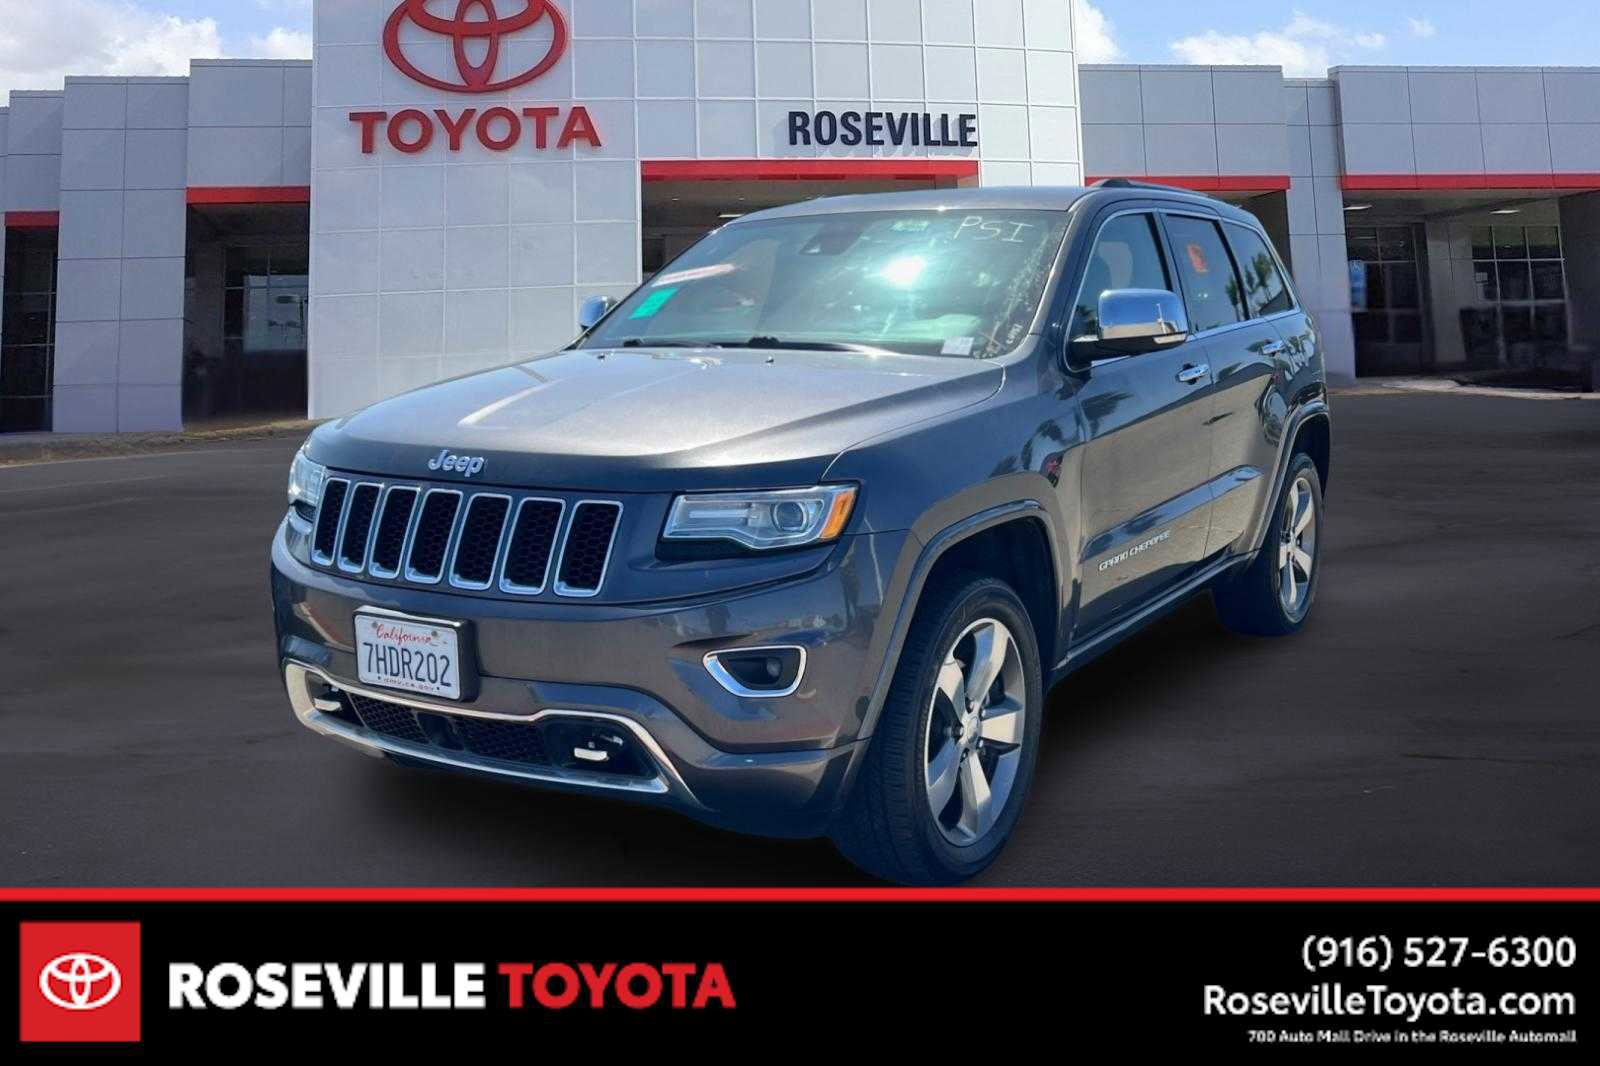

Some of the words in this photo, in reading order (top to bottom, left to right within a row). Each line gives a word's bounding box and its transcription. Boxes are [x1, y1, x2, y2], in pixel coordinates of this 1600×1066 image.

[349, 106, 602, 154] TOYOTA
[788, 111, 978, 147] ROSEVILLE
[953, 215, 1034, 243] PSI
[428, 449, 485, 478] Jeep
[1099, 550, 1129, 571] GRAND
[376, 622, 432, 646] California
[363, 642, 452, 687] 7HDR202
